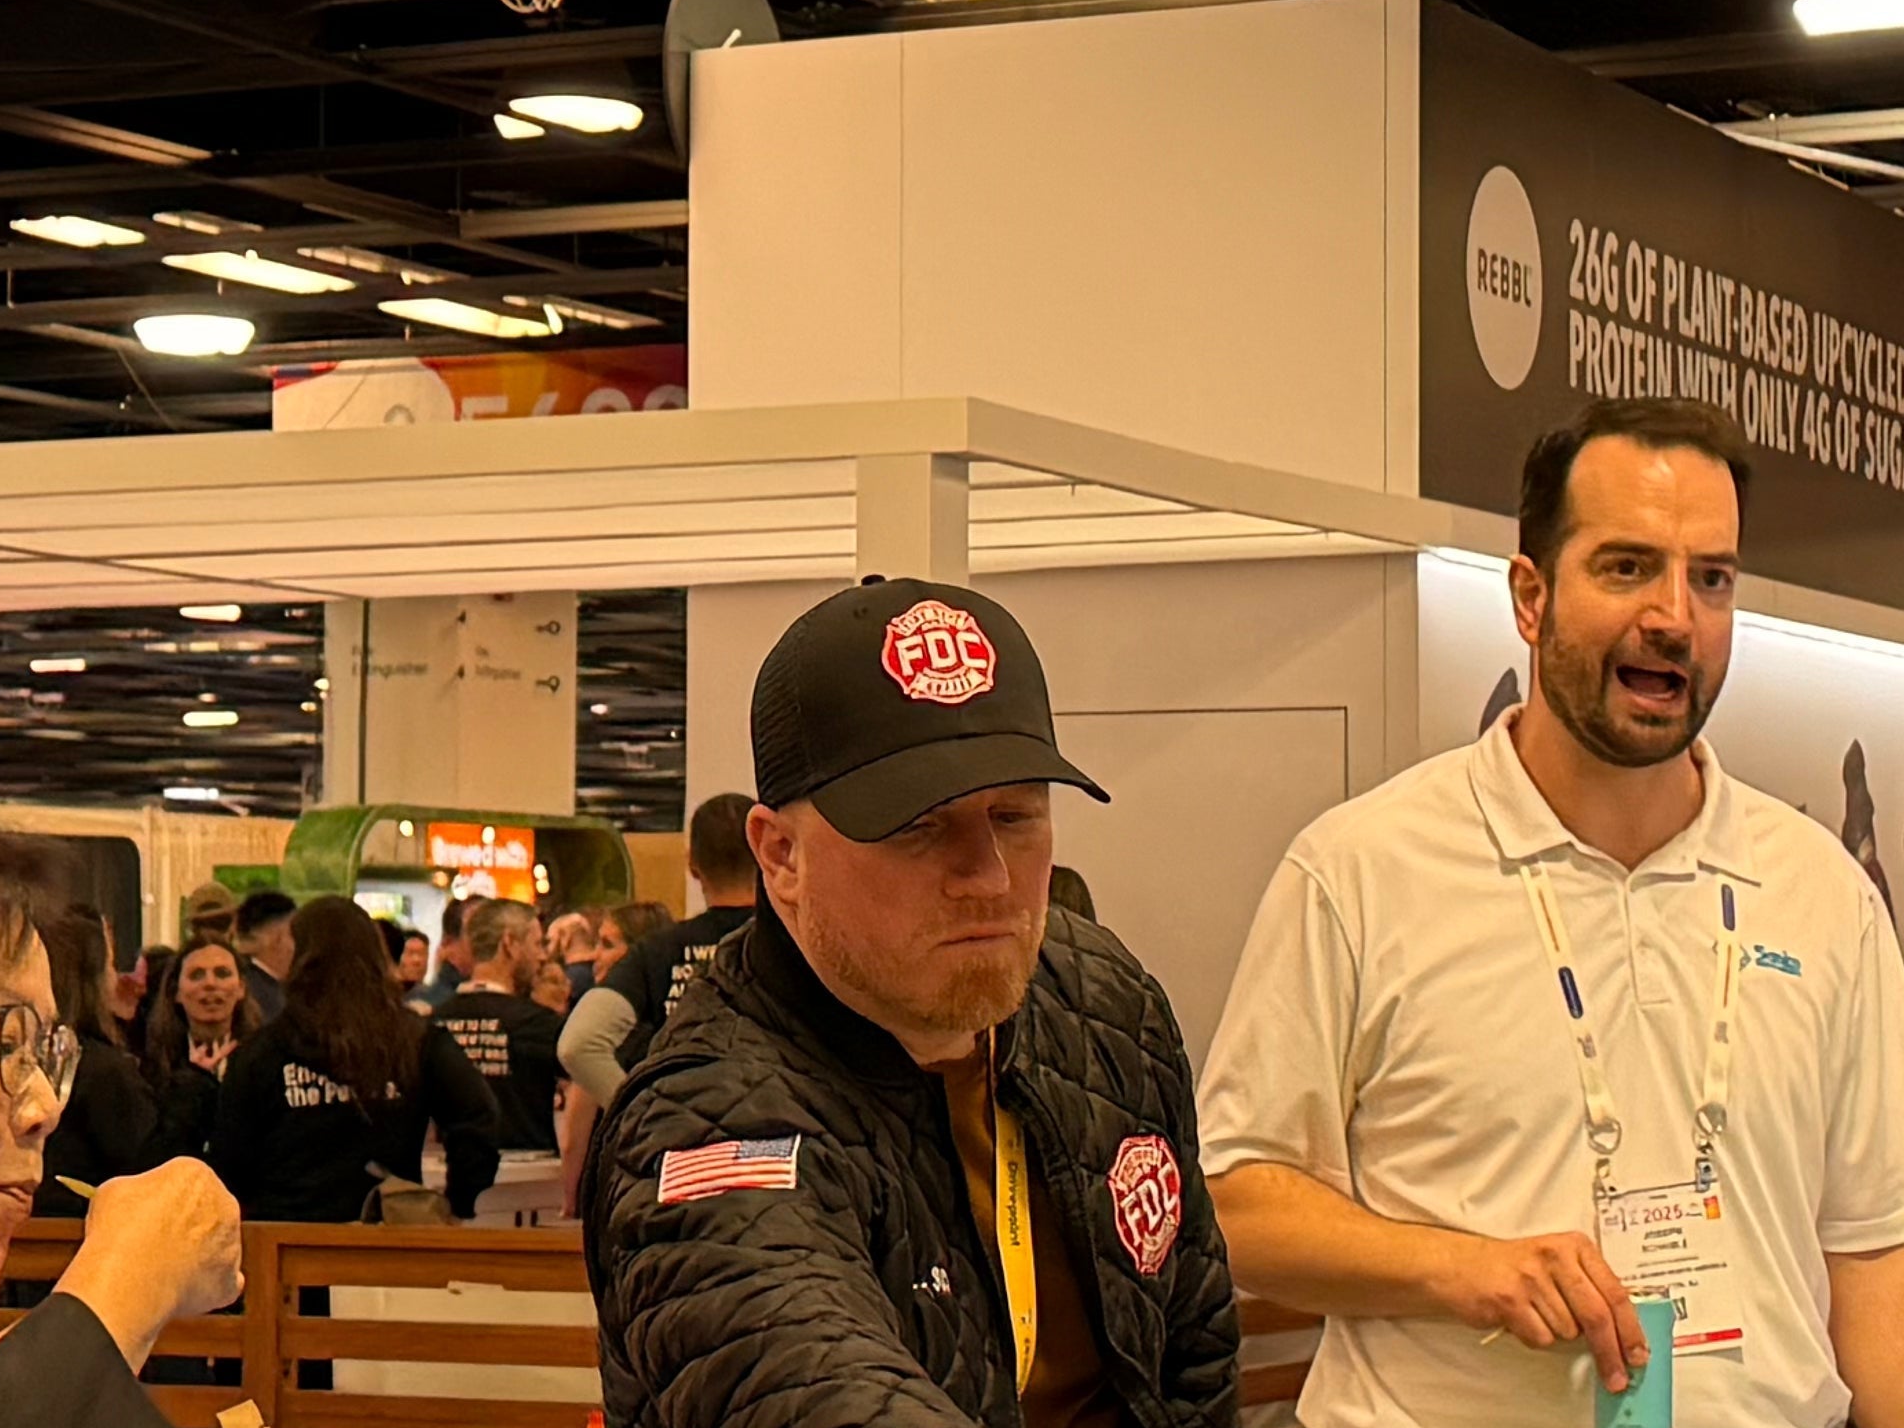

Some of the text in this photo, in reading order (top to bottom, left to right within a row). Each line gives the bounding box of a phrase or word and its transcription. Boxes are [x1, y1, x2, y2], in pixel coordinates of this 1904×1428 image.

[1477, 247, 1531, 308] REBBL
[1569, 218, 1619, 312] 26G
[1624, 240, 1660, 322] OF
[1664, 254, 1807, 377] PLANT-BASED
[1569, 310, 1672, 398] PROTEIN
[1676, 343, 1736, 422] WITH
[1744, 367, 1797, 455] ONLY
[1802, 392, 1832, 465] 4G
[1836, 405, 1863, 474] OF
[895, 630, 987, 677] FDC
[1120, 1162, 1179, 1247] FDC
[1643, 1204, 1683, 1224] 2025
